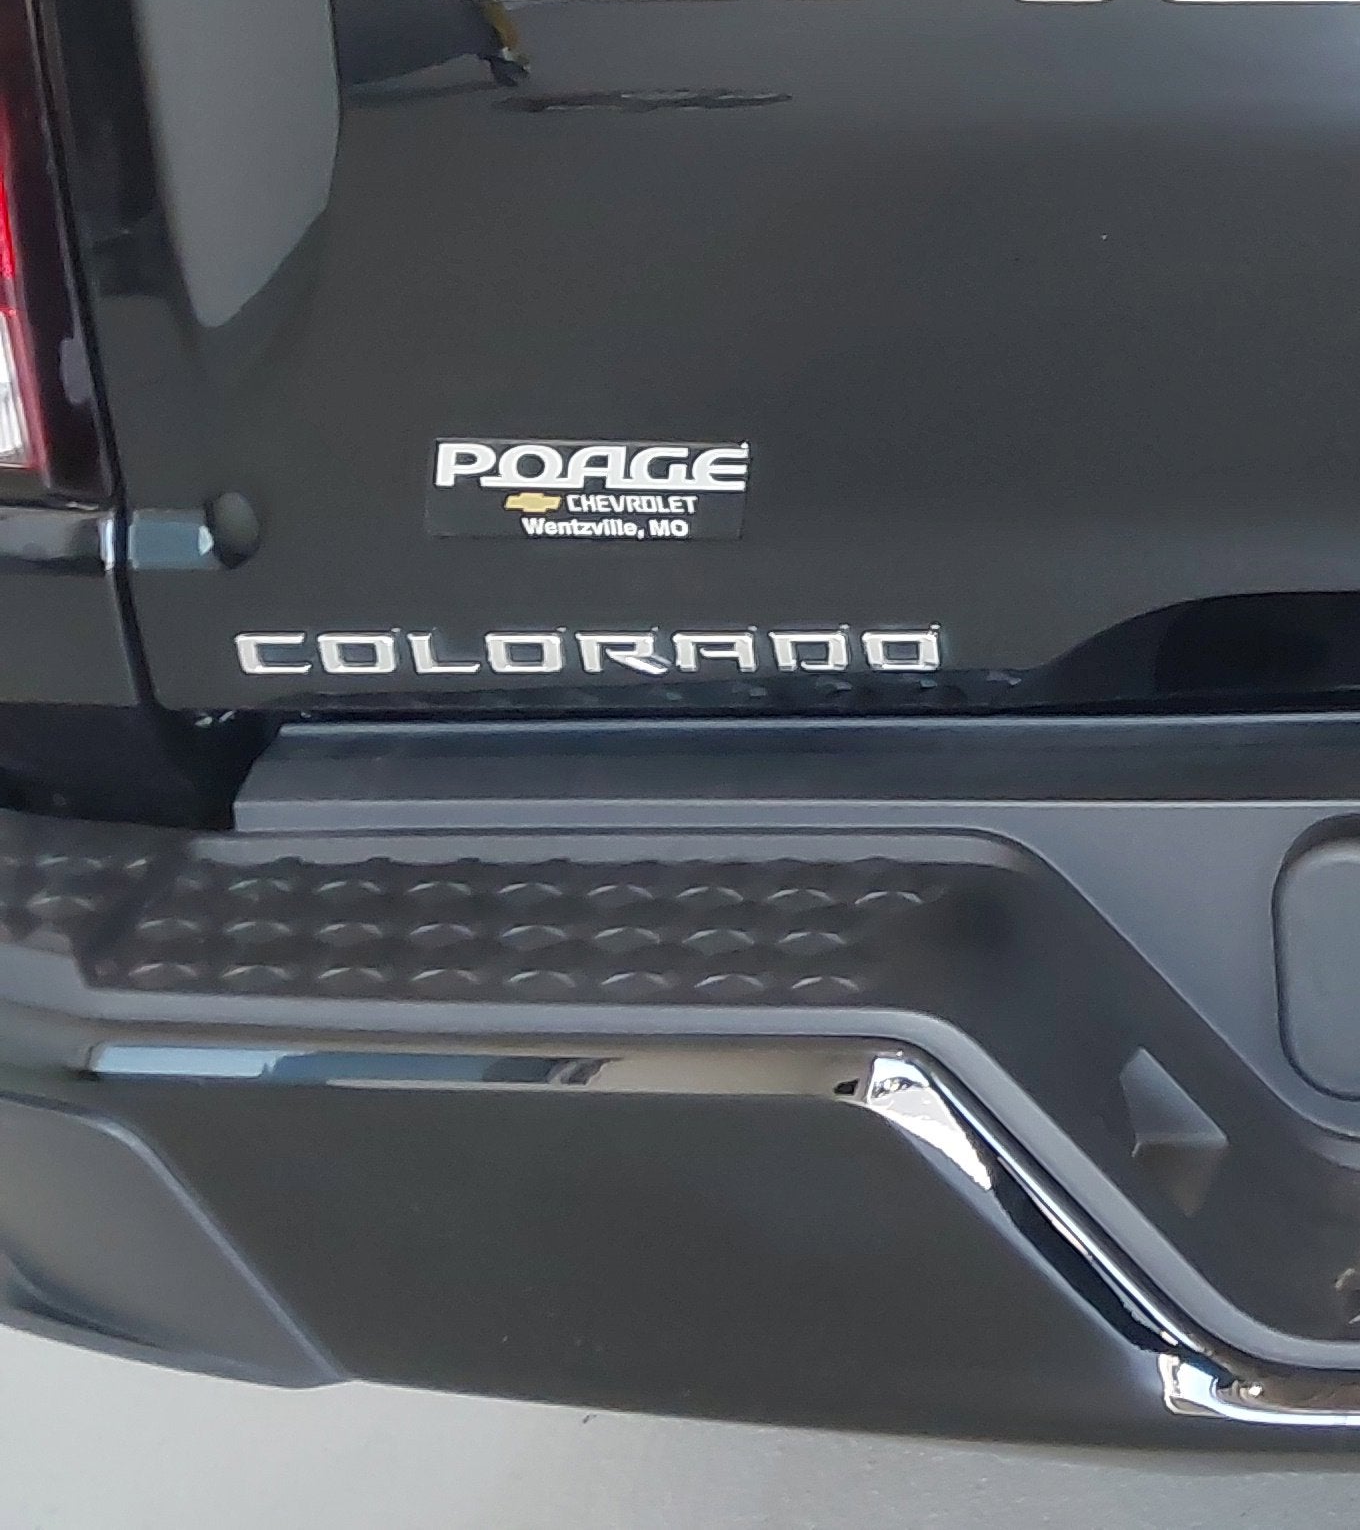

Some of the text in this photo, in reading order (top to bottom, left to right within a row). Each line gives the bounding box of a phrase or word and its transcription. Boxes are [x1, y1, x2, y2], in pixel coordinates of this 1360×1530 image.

[435, 443, 749, 491] POAGE
[566, 494, 698, 514] CHEVROLET
[521, 517, 689, 539] Wentzville, MO
[234, 627, 942, 674] COLORADO
